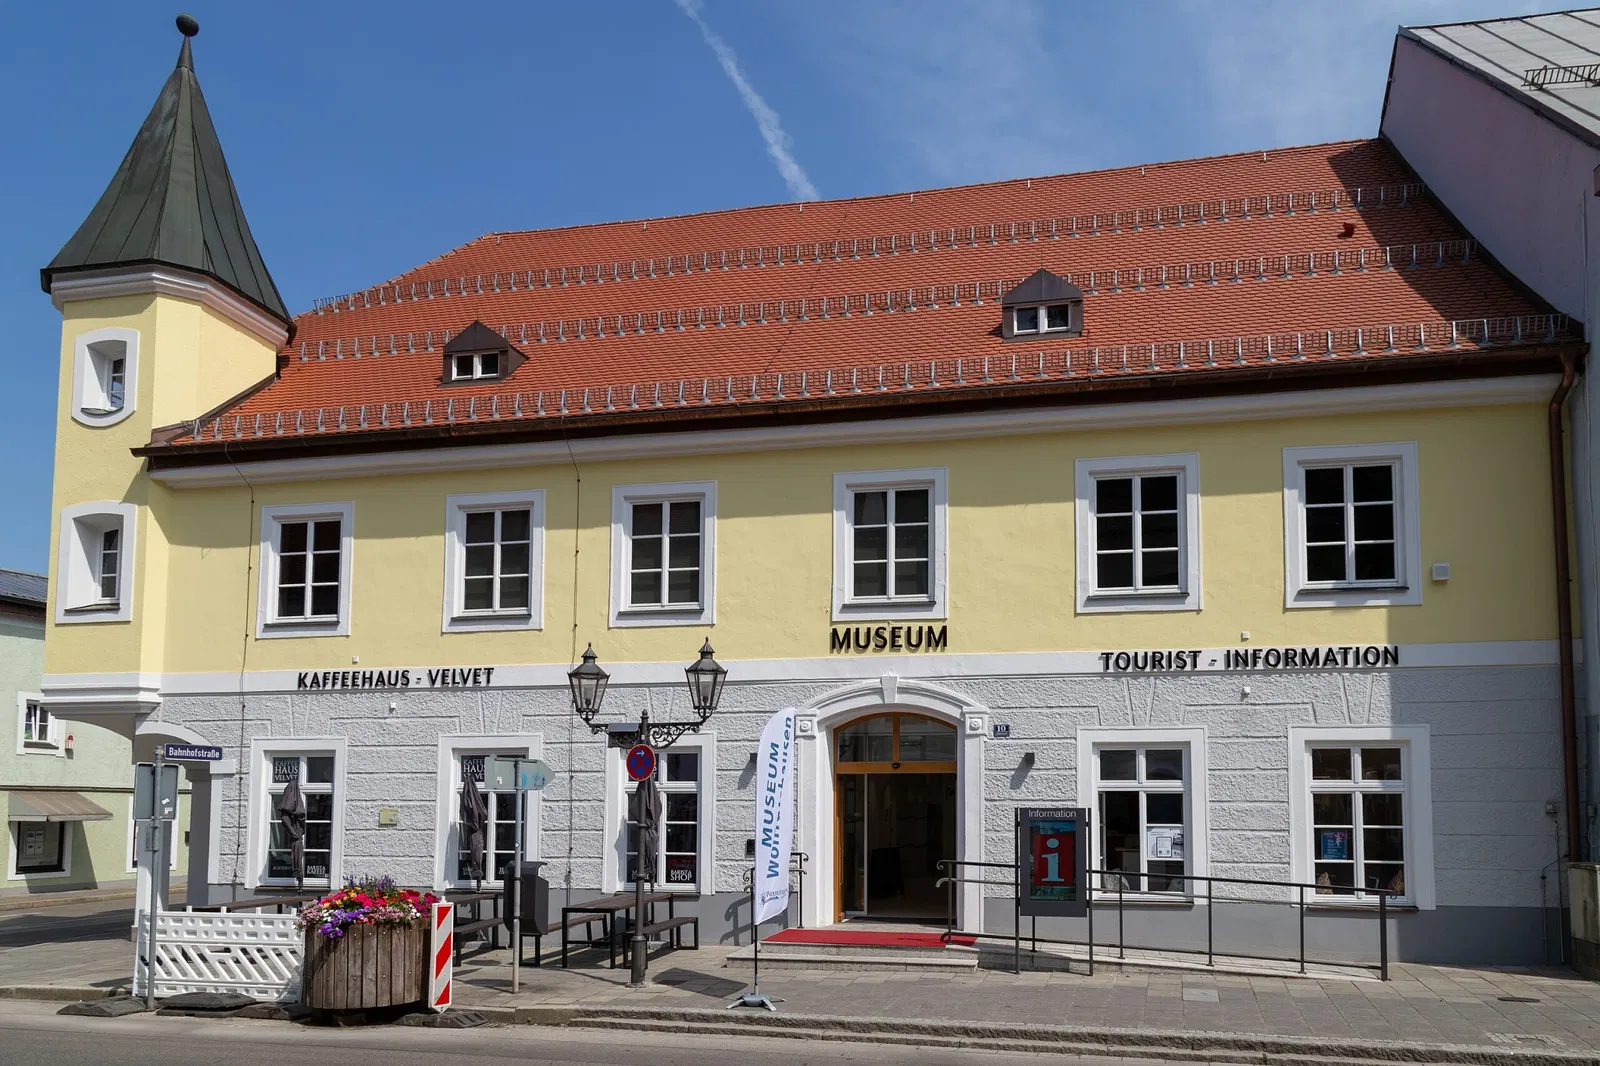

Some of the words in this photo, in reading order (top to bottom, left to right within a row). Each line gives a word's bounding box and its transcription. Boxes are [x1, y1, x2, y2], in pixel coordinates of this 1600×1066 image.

[831, 625, 947, 650] MUSEUM
[1101, 650, 1202, 670] TOURIST
[1226, 646, 1399, 669] INFORMATION
[298, 670, 410, 688] KAFFEEHAUS
[428, 668, 494, 686] VELVET
[169, 747, 220, 758] Bahnhofstraße
[275, 766, 299, 774] HAUS
[762, 742, 779, 848] MUSEUM
[1028, 809, 1077, 818] Information
